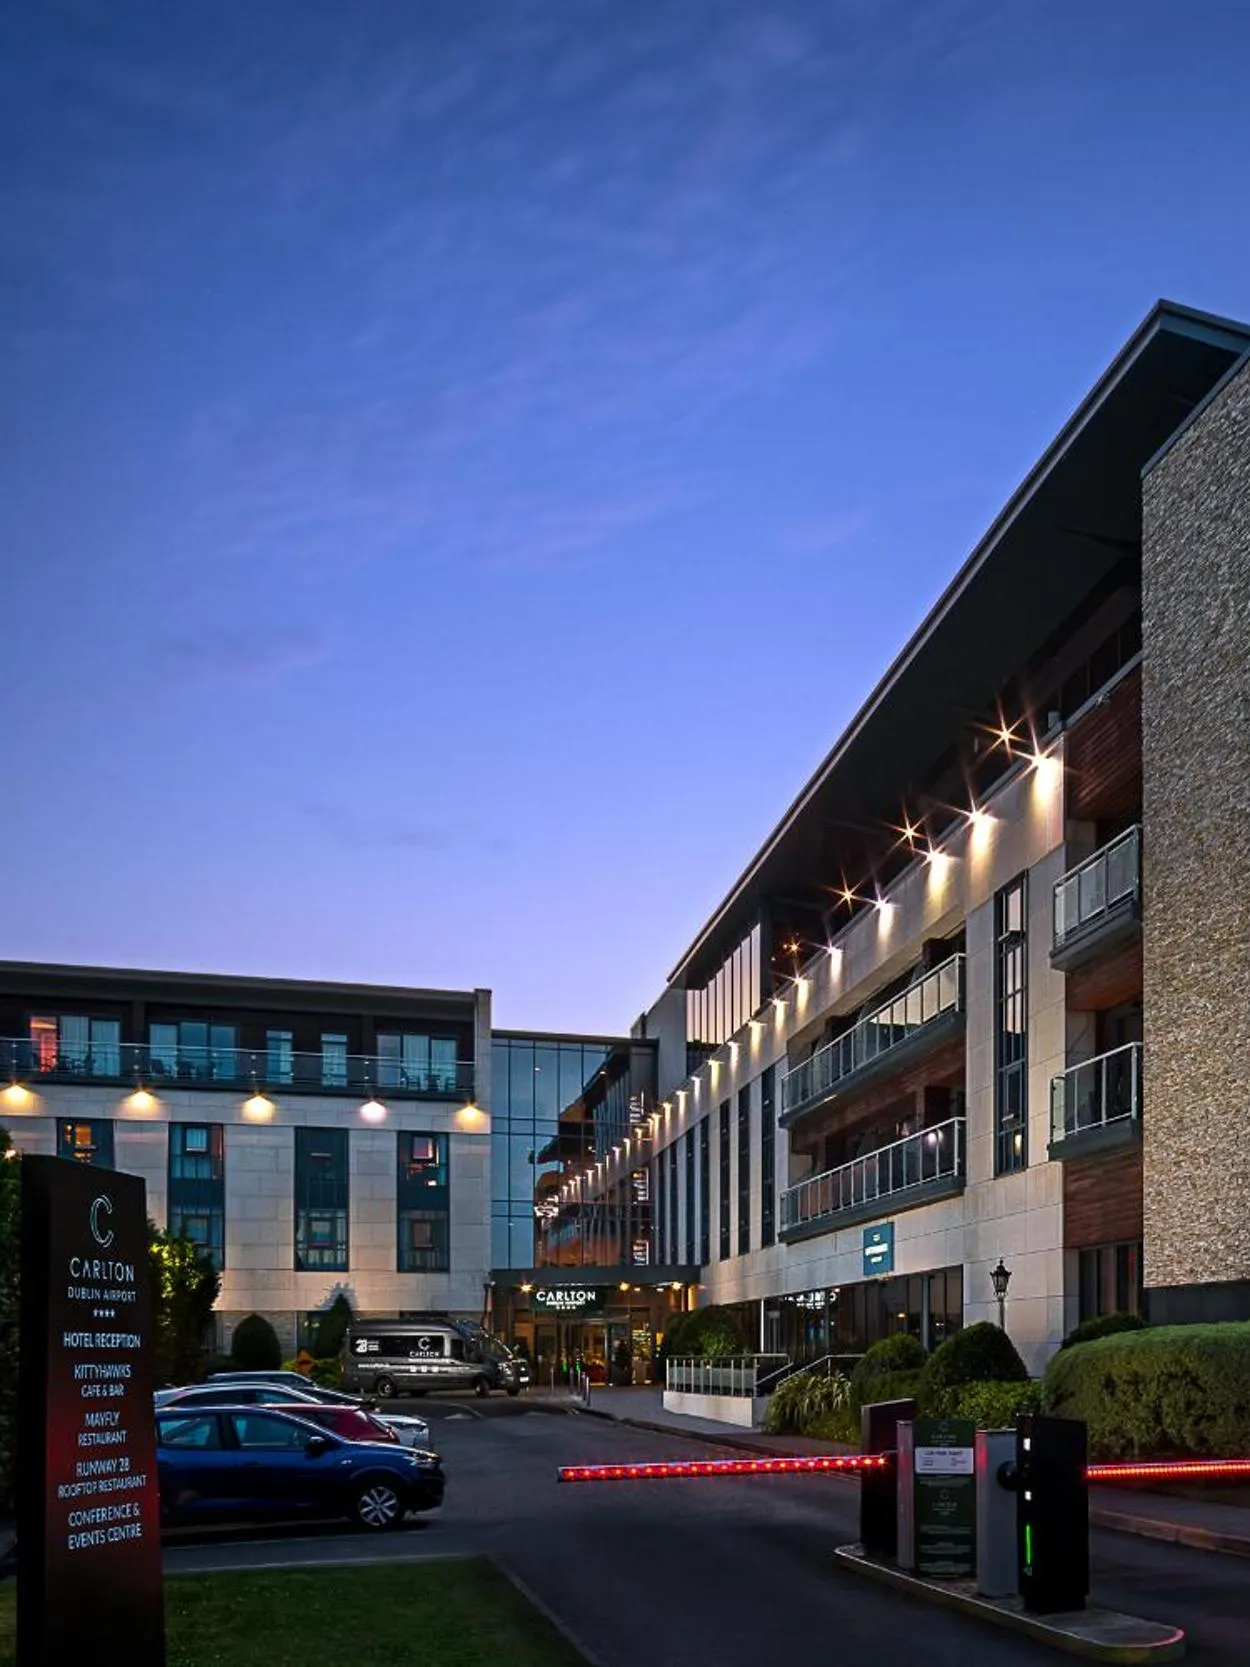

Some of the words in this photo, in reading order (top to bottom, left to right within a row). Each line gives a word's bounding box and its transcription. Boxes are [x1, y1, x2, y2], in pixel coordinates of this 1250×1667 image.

[69, 1257, 134, 1282] CARLTON
[67, 1286, 100, 1299] DUBLIN
[103, 1289, 136, 1302] AIRPORT
[536, 1291, 596, 1301] CARLTON
[63, 1331, 94, 1348] HOTEL
[95, 1332, 141, 1348] RECEPTION
[74, 1364, 131, 1379] KITTYHAWKS
[109, 1383, 124, 1396] BAR
[85, 1411, 120, 1427] MAYFLY
[78, 1430, 126, 1446] RESTAURANT
[76, 1458, 117, 1476] RUNWAY
[57, 1481, 97, 1498] ROOFTOP
[99, 1474, 146, 1491] RESTAURANT
[67, 1503, 131, 1527] CONFERENCE
[133, 1502, 141, 1516] &
[67, 1529, 106, 1550] EVENTS
[107, 1523, 142, 1542] CENTRE
